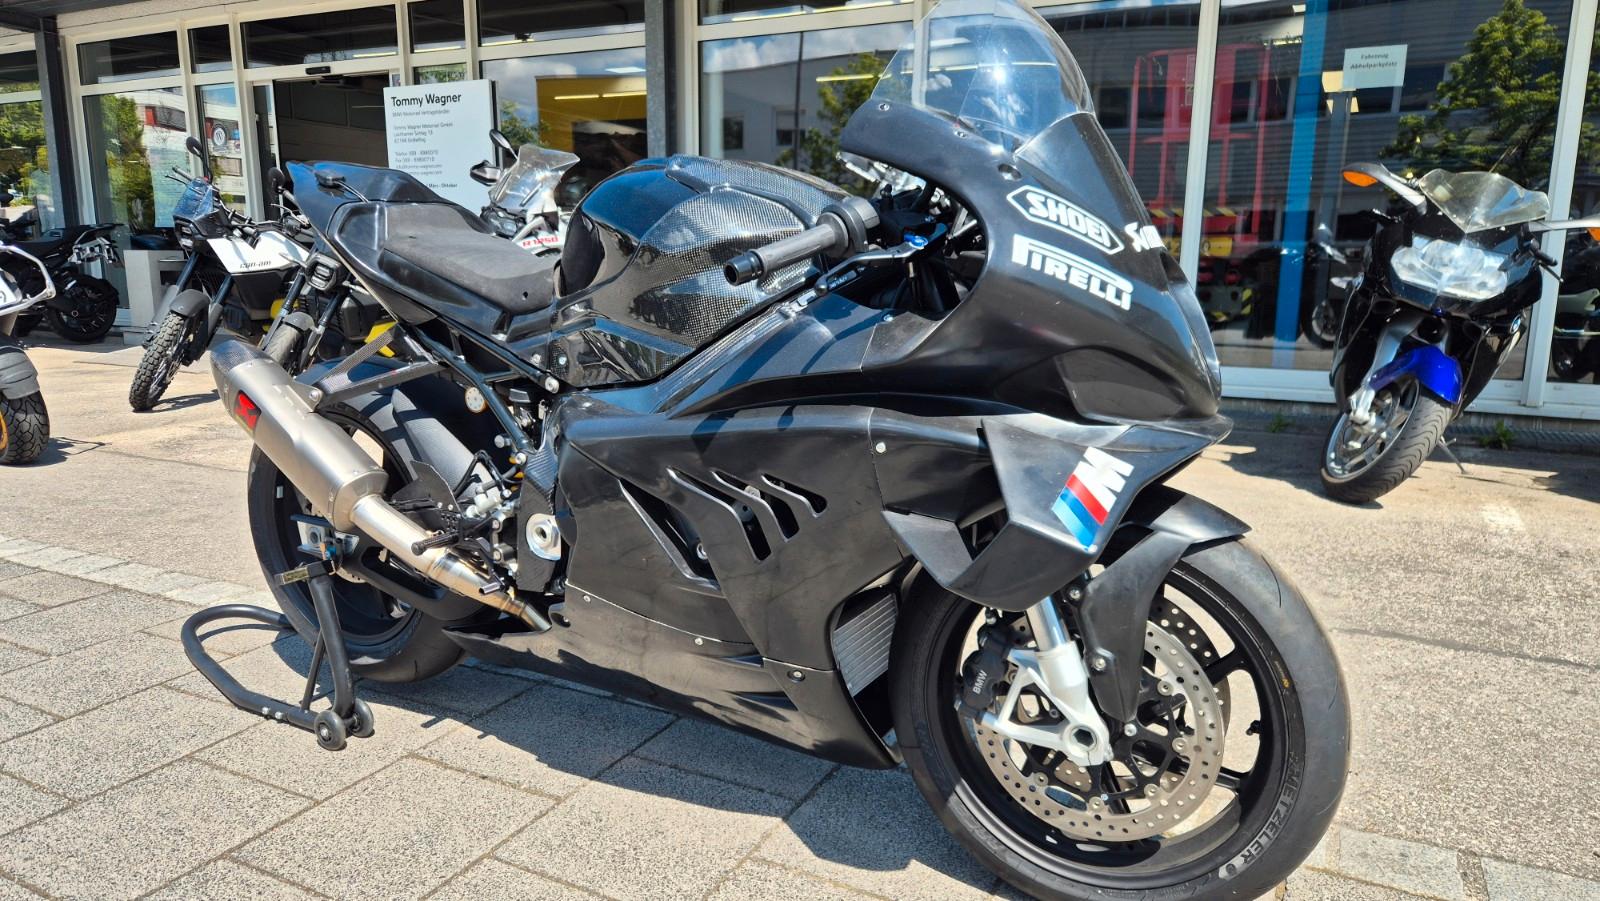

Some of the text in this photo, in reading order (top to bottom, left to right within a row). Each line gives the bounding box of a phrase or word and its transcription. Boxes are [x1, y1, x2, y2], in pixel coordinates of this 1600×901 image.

[391, 93, 461, 107] Tommy Wagner
[1026, 192, 1111, 247] SHOEI
[1011, 233, 1134, 311] PIRELLI
[972, 669, 988, 695] BMW
[1240, 772, 1300, 865] METZELER
